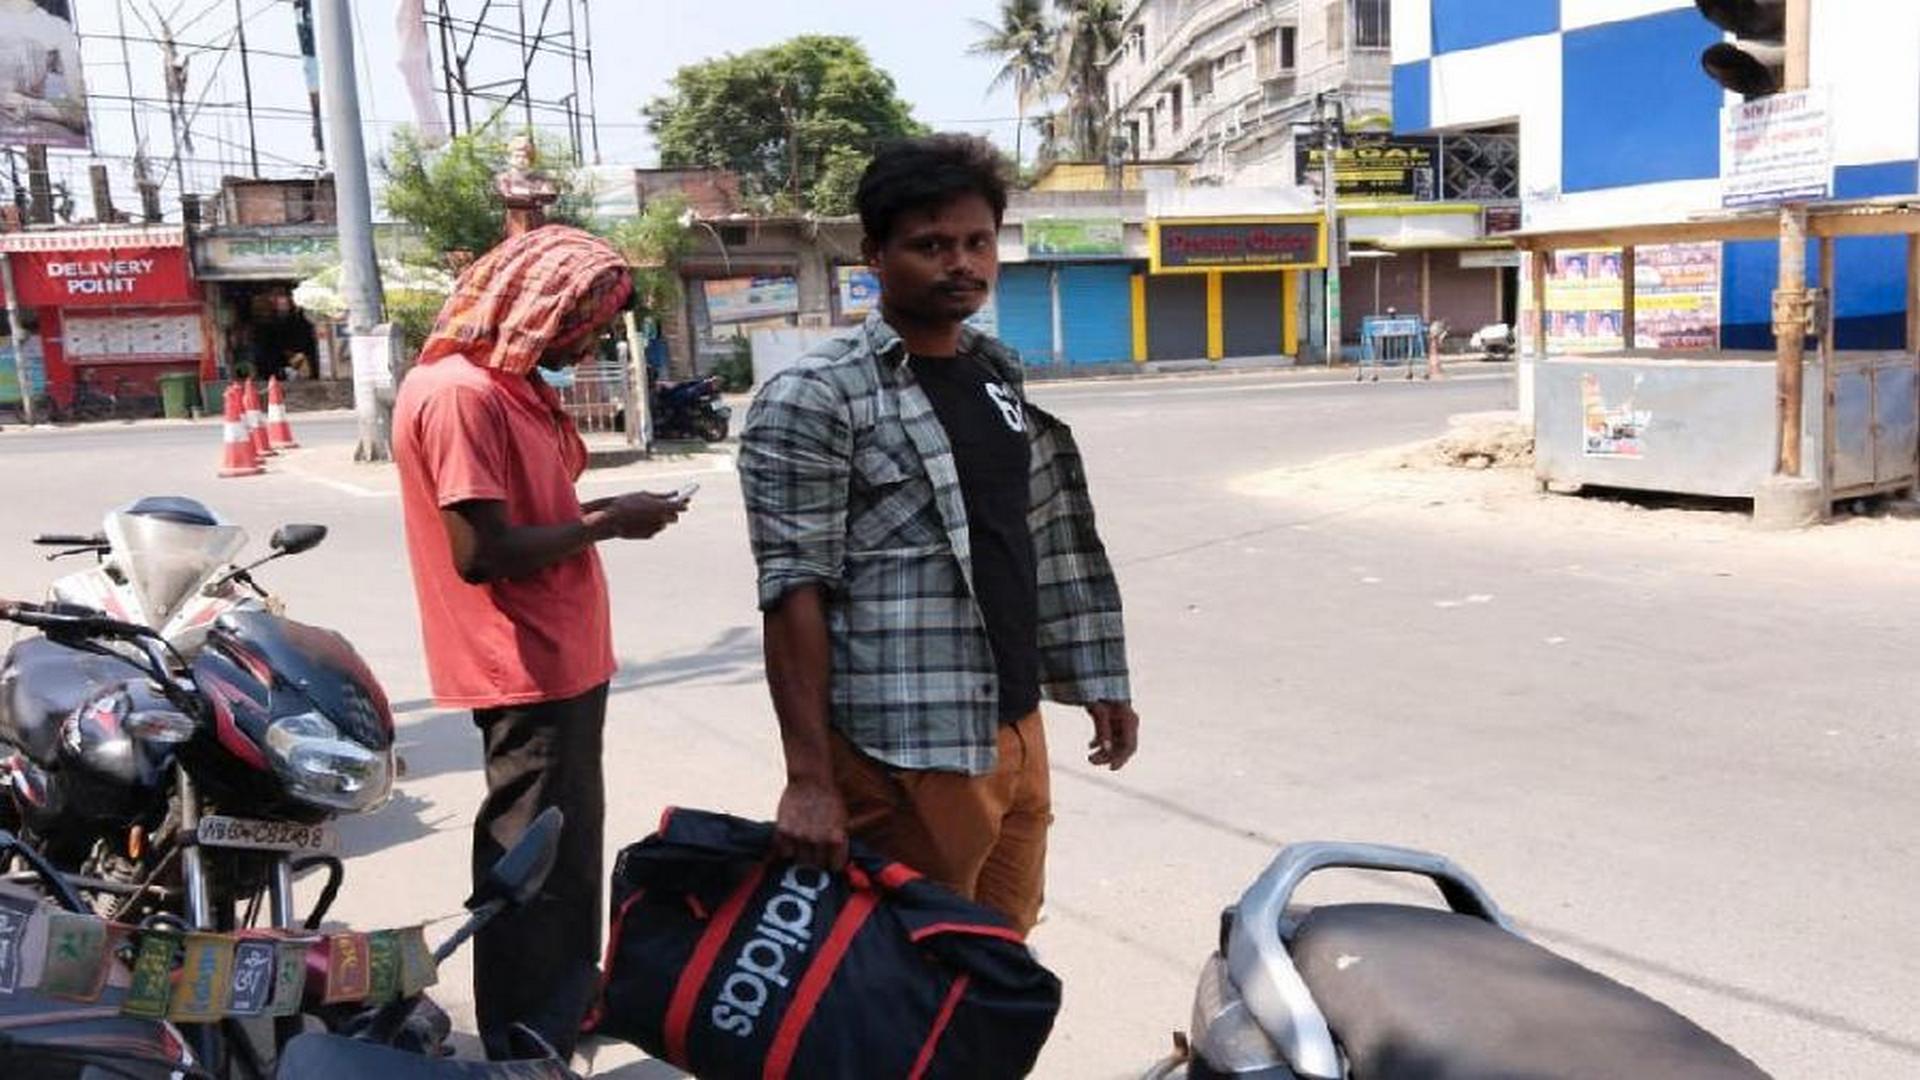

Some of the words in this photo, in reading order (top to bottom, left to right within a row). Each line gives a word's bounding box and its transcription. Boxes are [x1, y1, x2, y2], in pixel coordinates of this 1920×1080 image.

[46, 259, 154, 277] DELIVERY
[67, 277, 136, 294] POINT
[711, 865, 831, 1037] adidas
